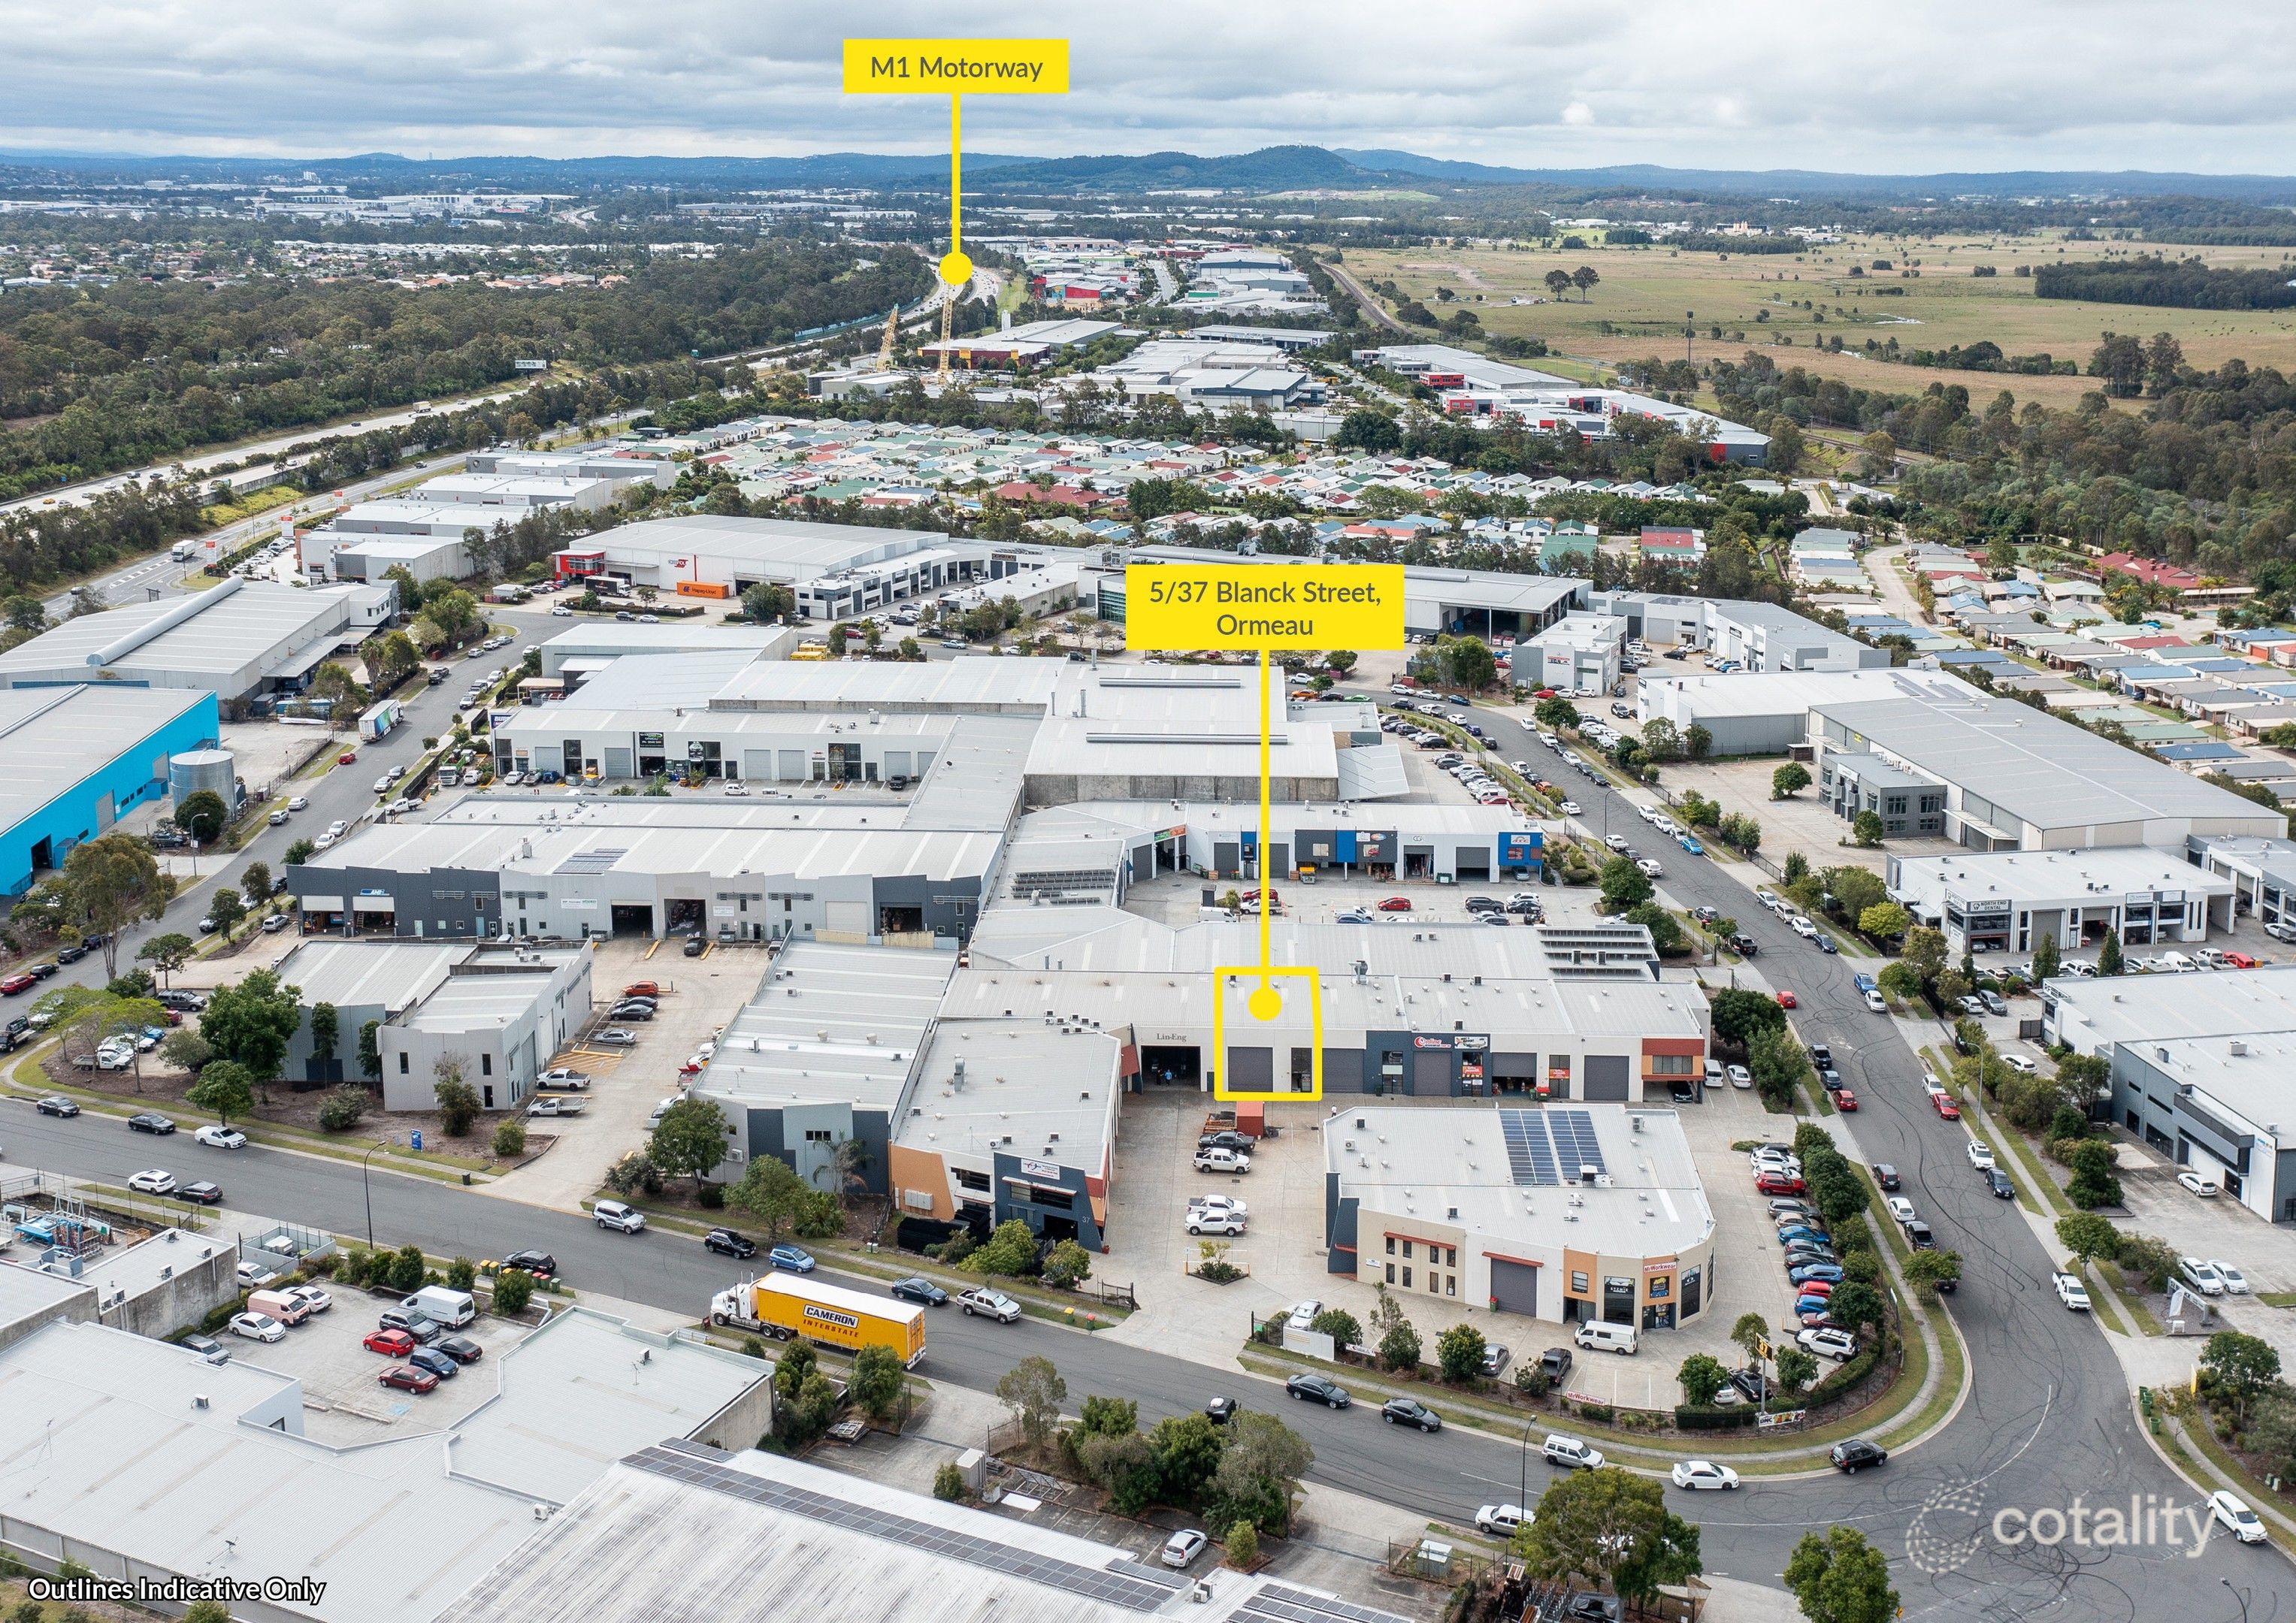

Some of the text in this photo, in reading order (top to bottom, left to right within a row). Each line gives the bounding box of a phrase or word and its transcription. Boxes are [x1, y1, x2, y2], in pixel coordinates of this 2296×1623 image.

[1157, 1032, 1187, 1042] Lin-Eng
[1082, 1215, 1091, 1223] 37
[1644, 1263, 1676, 1271] MrWorkwear
[806, 1307, 856, 1326] CAMERON
[803, 1319, 860, 1338] INTERSTATE
[1759, 1339, 1768, 1356] 37
[1568, 1392, 1604, 1404] MrWorkwear
